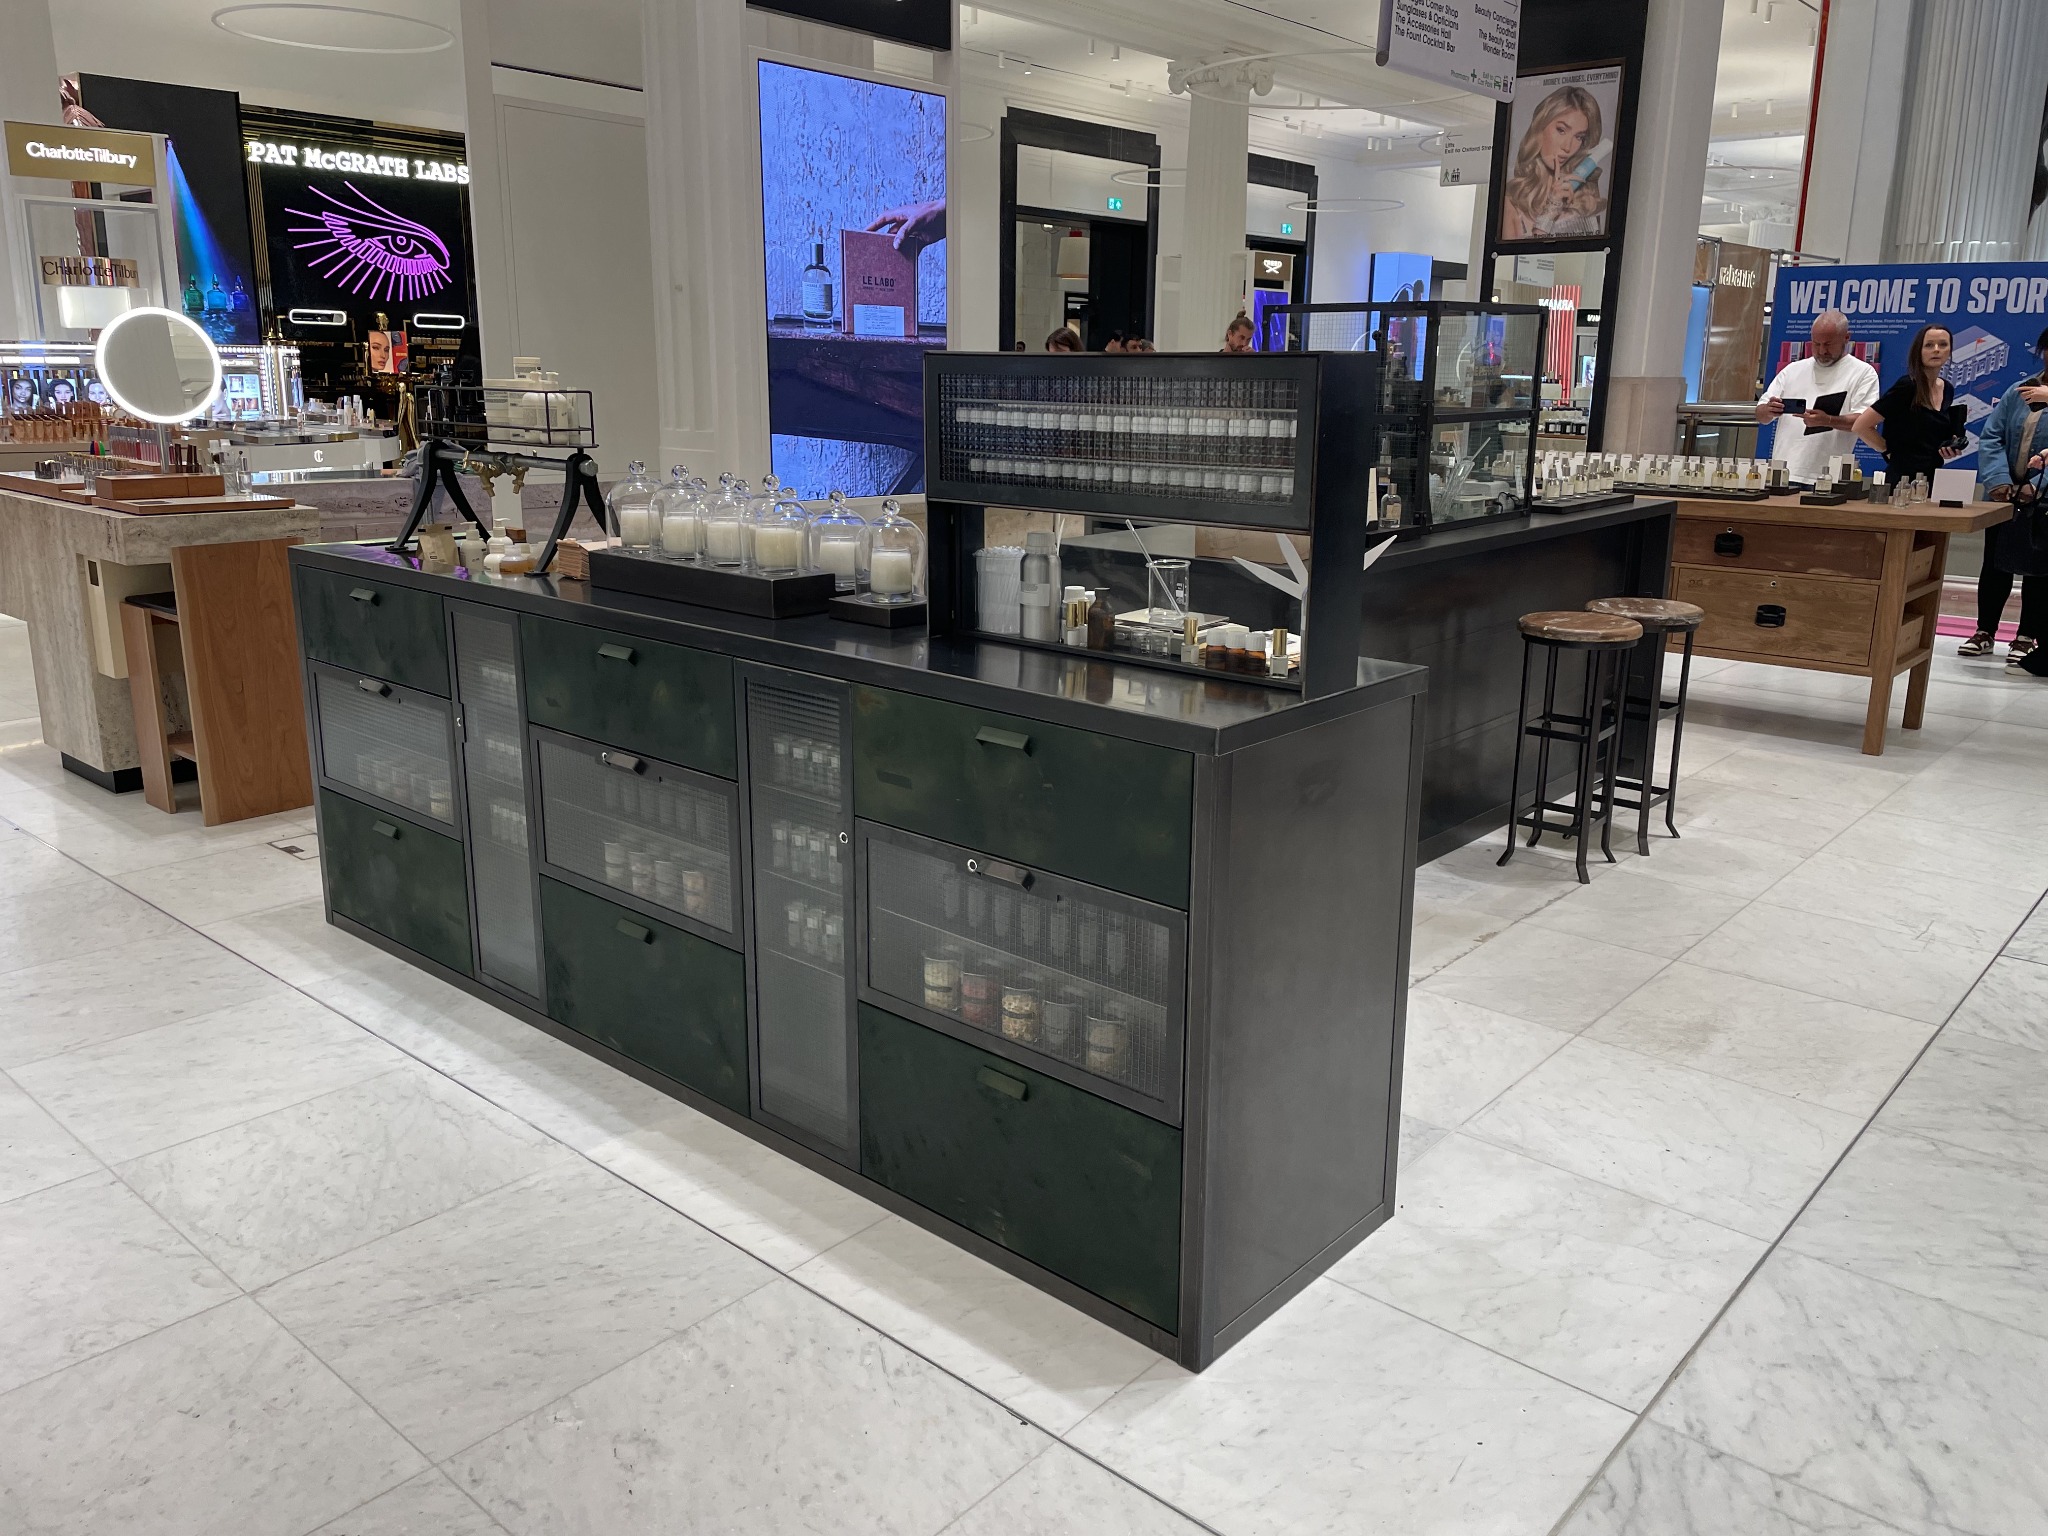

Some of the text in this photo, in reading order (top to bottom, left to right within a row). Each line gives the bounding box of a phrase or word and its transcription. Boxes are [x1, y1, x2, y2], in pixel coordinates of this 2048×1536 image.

[1396, 0, 1427, 19] Sunglasses
[1433, 13, 1459, 30] Opticians
[1444, 5, 1459, 19] Shop
[1474, 4, 1518, 29] Beauty Concierge
[1395, 12, 1452, 39] The Accessories Hall
[1495, 24, 1517, 39] Foodhall
[1395, 25, 1456, 53] The Fount Cocktail Bar
[1478, 29, 1516, 50] The Beauty Spot
[1482, 42, 1516, 60] Wonder Room
[247, 141, 470, 184] PAT McGRATH LABS
[862, 275, 895, 288] LE LABO
[1790, 278, 1919, 314] WELCOME
[1926, 278, 1961, 313] TO
